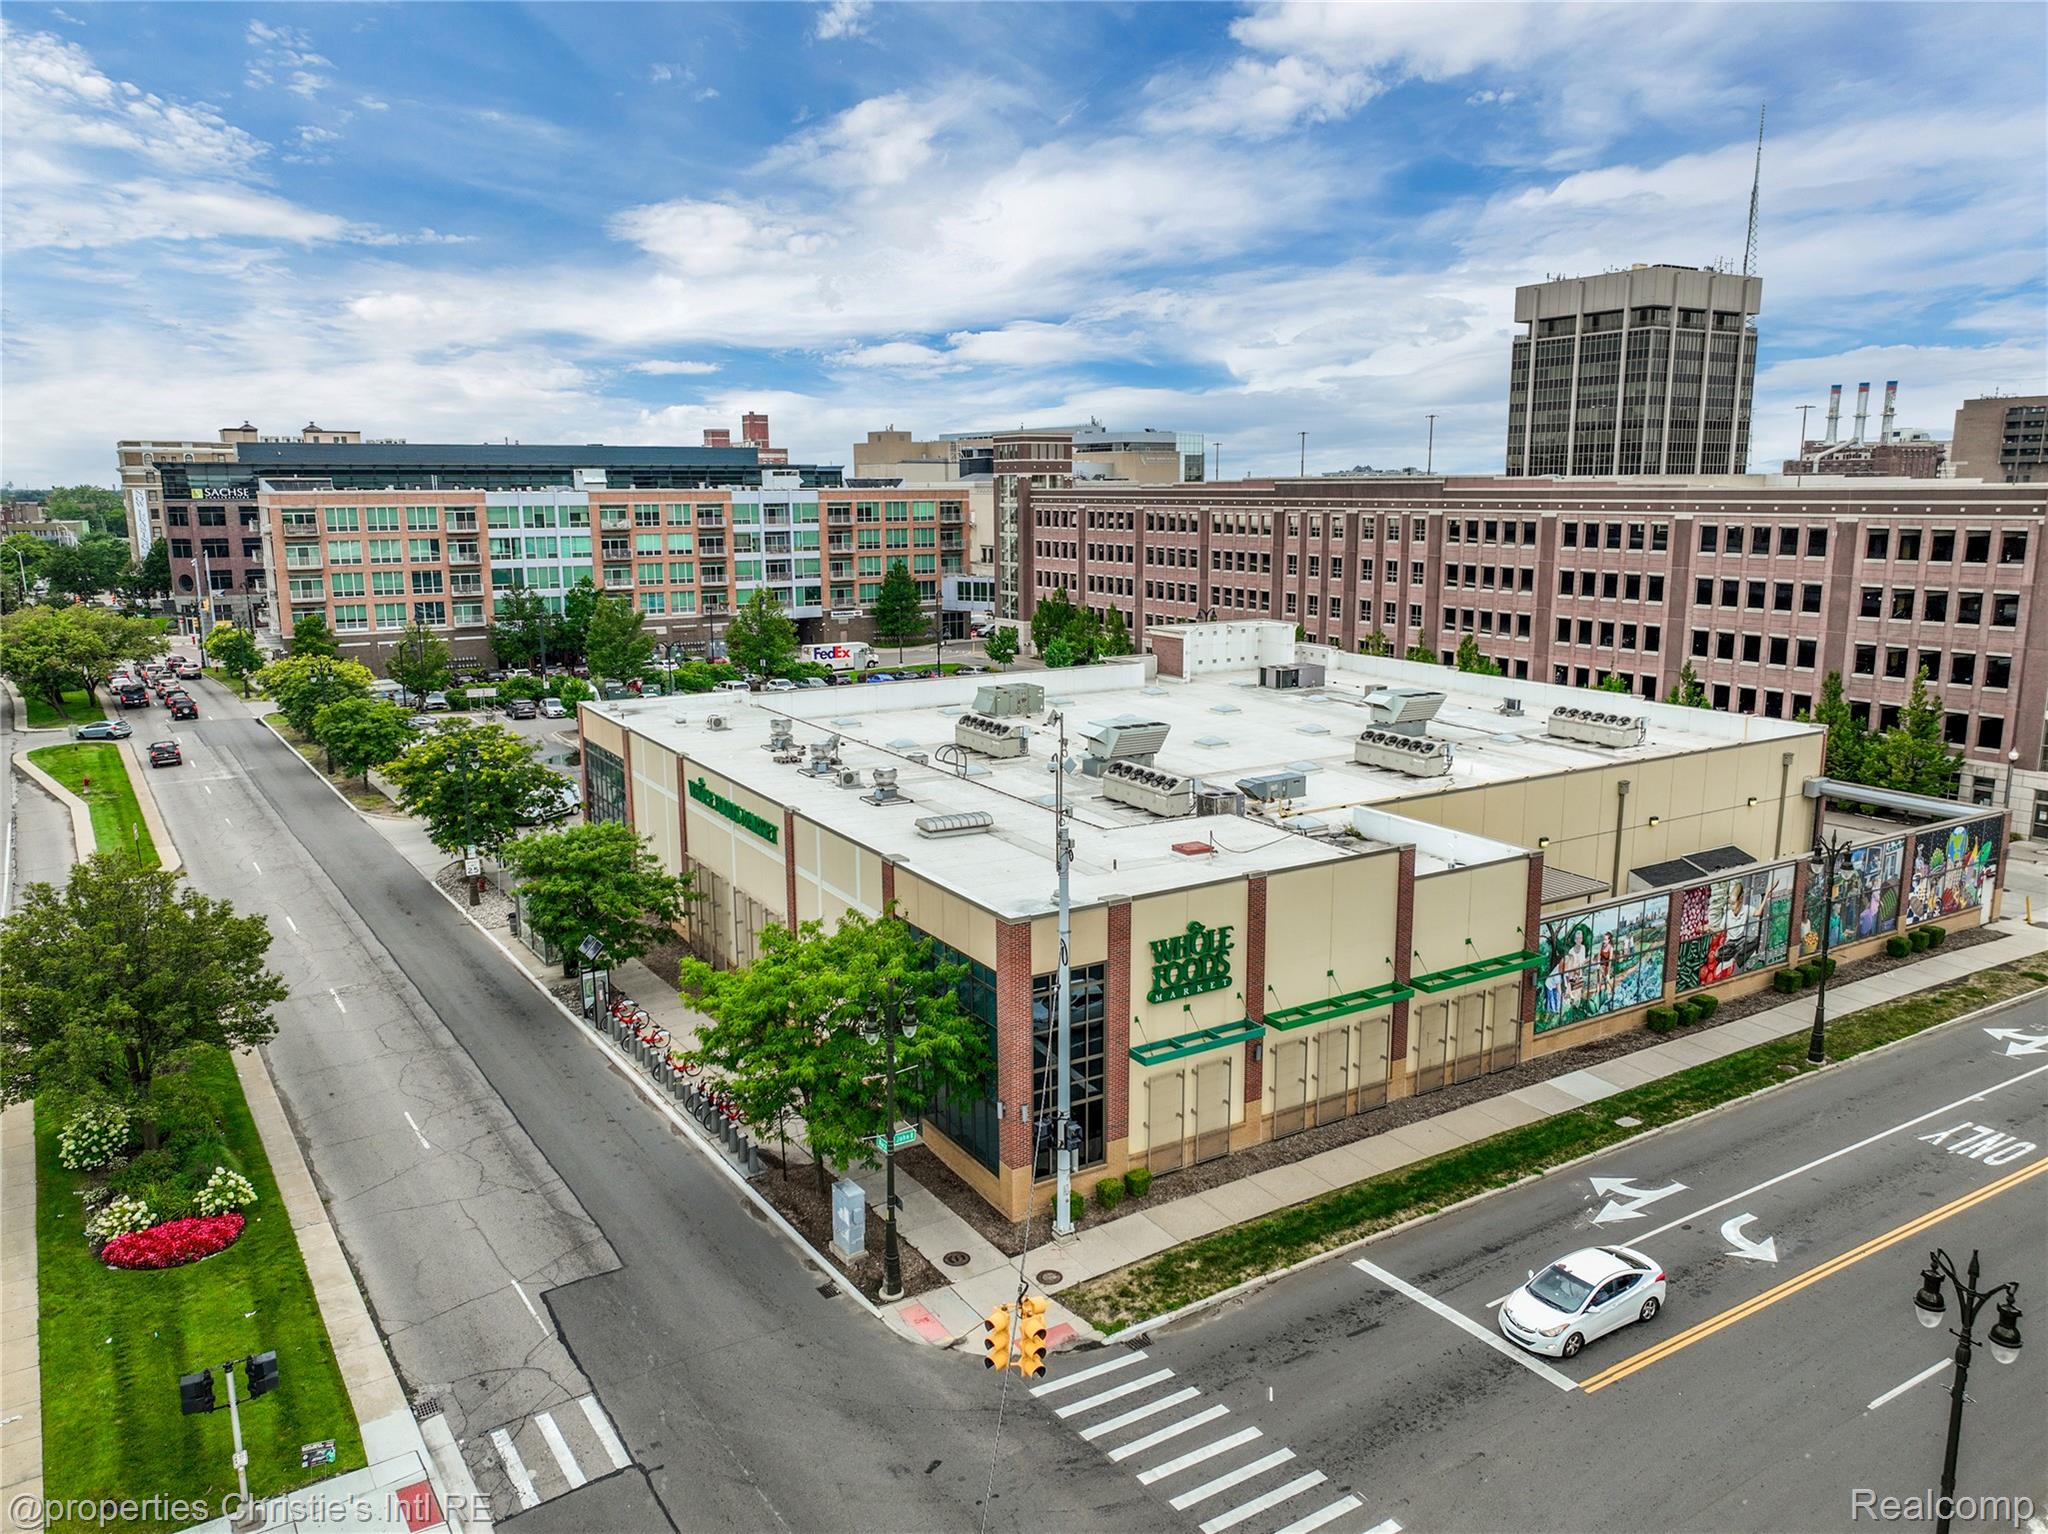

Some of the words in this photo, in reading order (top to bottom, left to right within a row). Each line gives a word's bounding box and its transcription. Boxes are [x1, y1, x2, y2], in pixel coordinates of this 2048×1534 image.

[204, 488, 250, 497] SACHSE
[814, 646, 850, 660] FedEx
[1149, 925, 1234, 964] WHOLE
[1152, 951, 1231, 991] FOODS
[1155, 979, 1229, 1002] MARKET
[1918, 1121, 2037, 1166] ONLY
